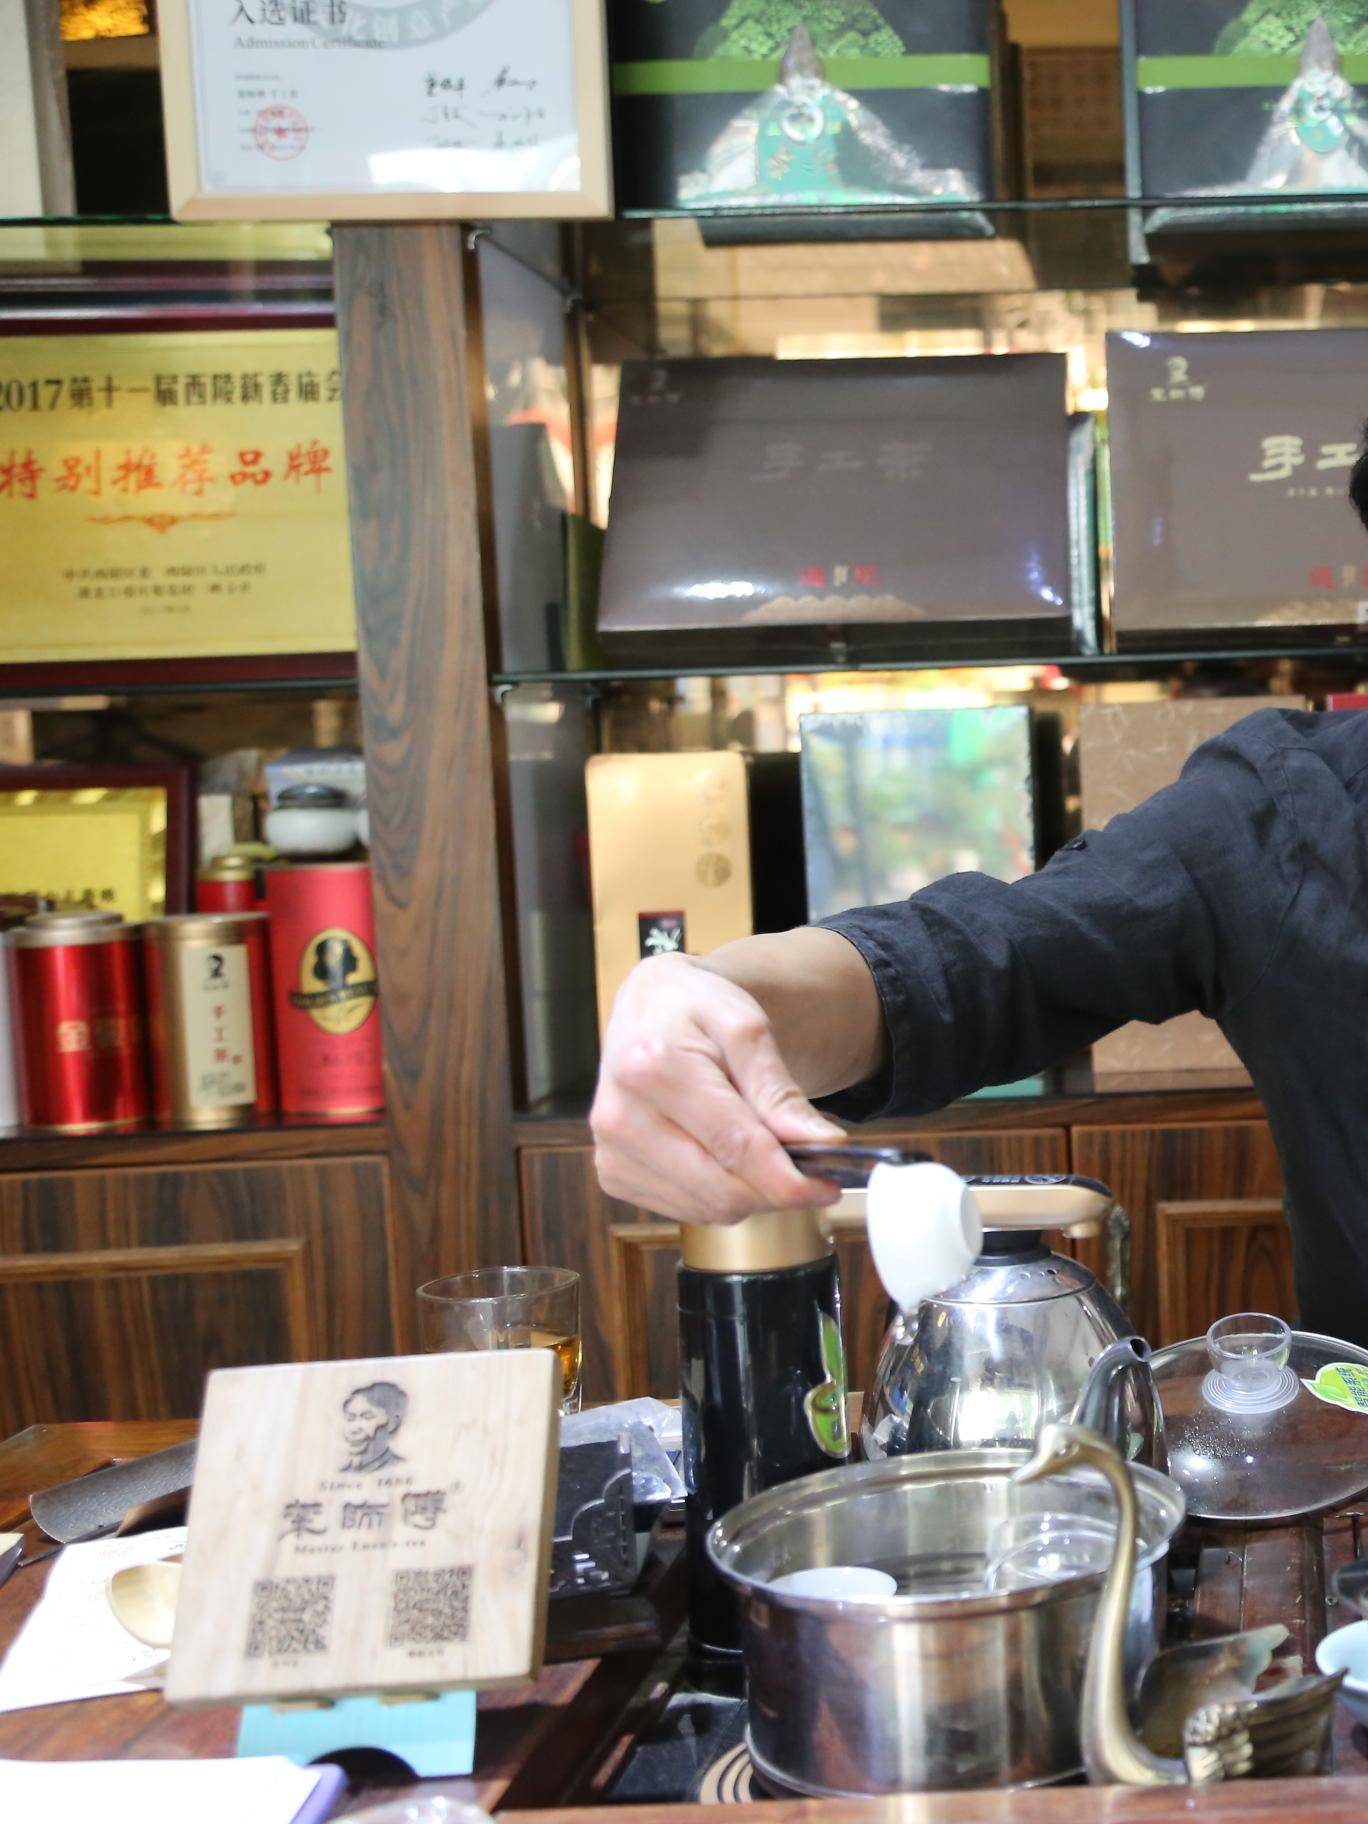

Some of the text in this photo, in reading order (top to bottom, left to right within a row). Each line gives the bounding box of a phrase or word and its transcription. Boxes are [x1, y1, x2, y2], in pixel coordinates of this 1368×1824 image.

[233, 36, 309, 50] Admission
[0, 438, 334, 501] 特别推荐品牌
